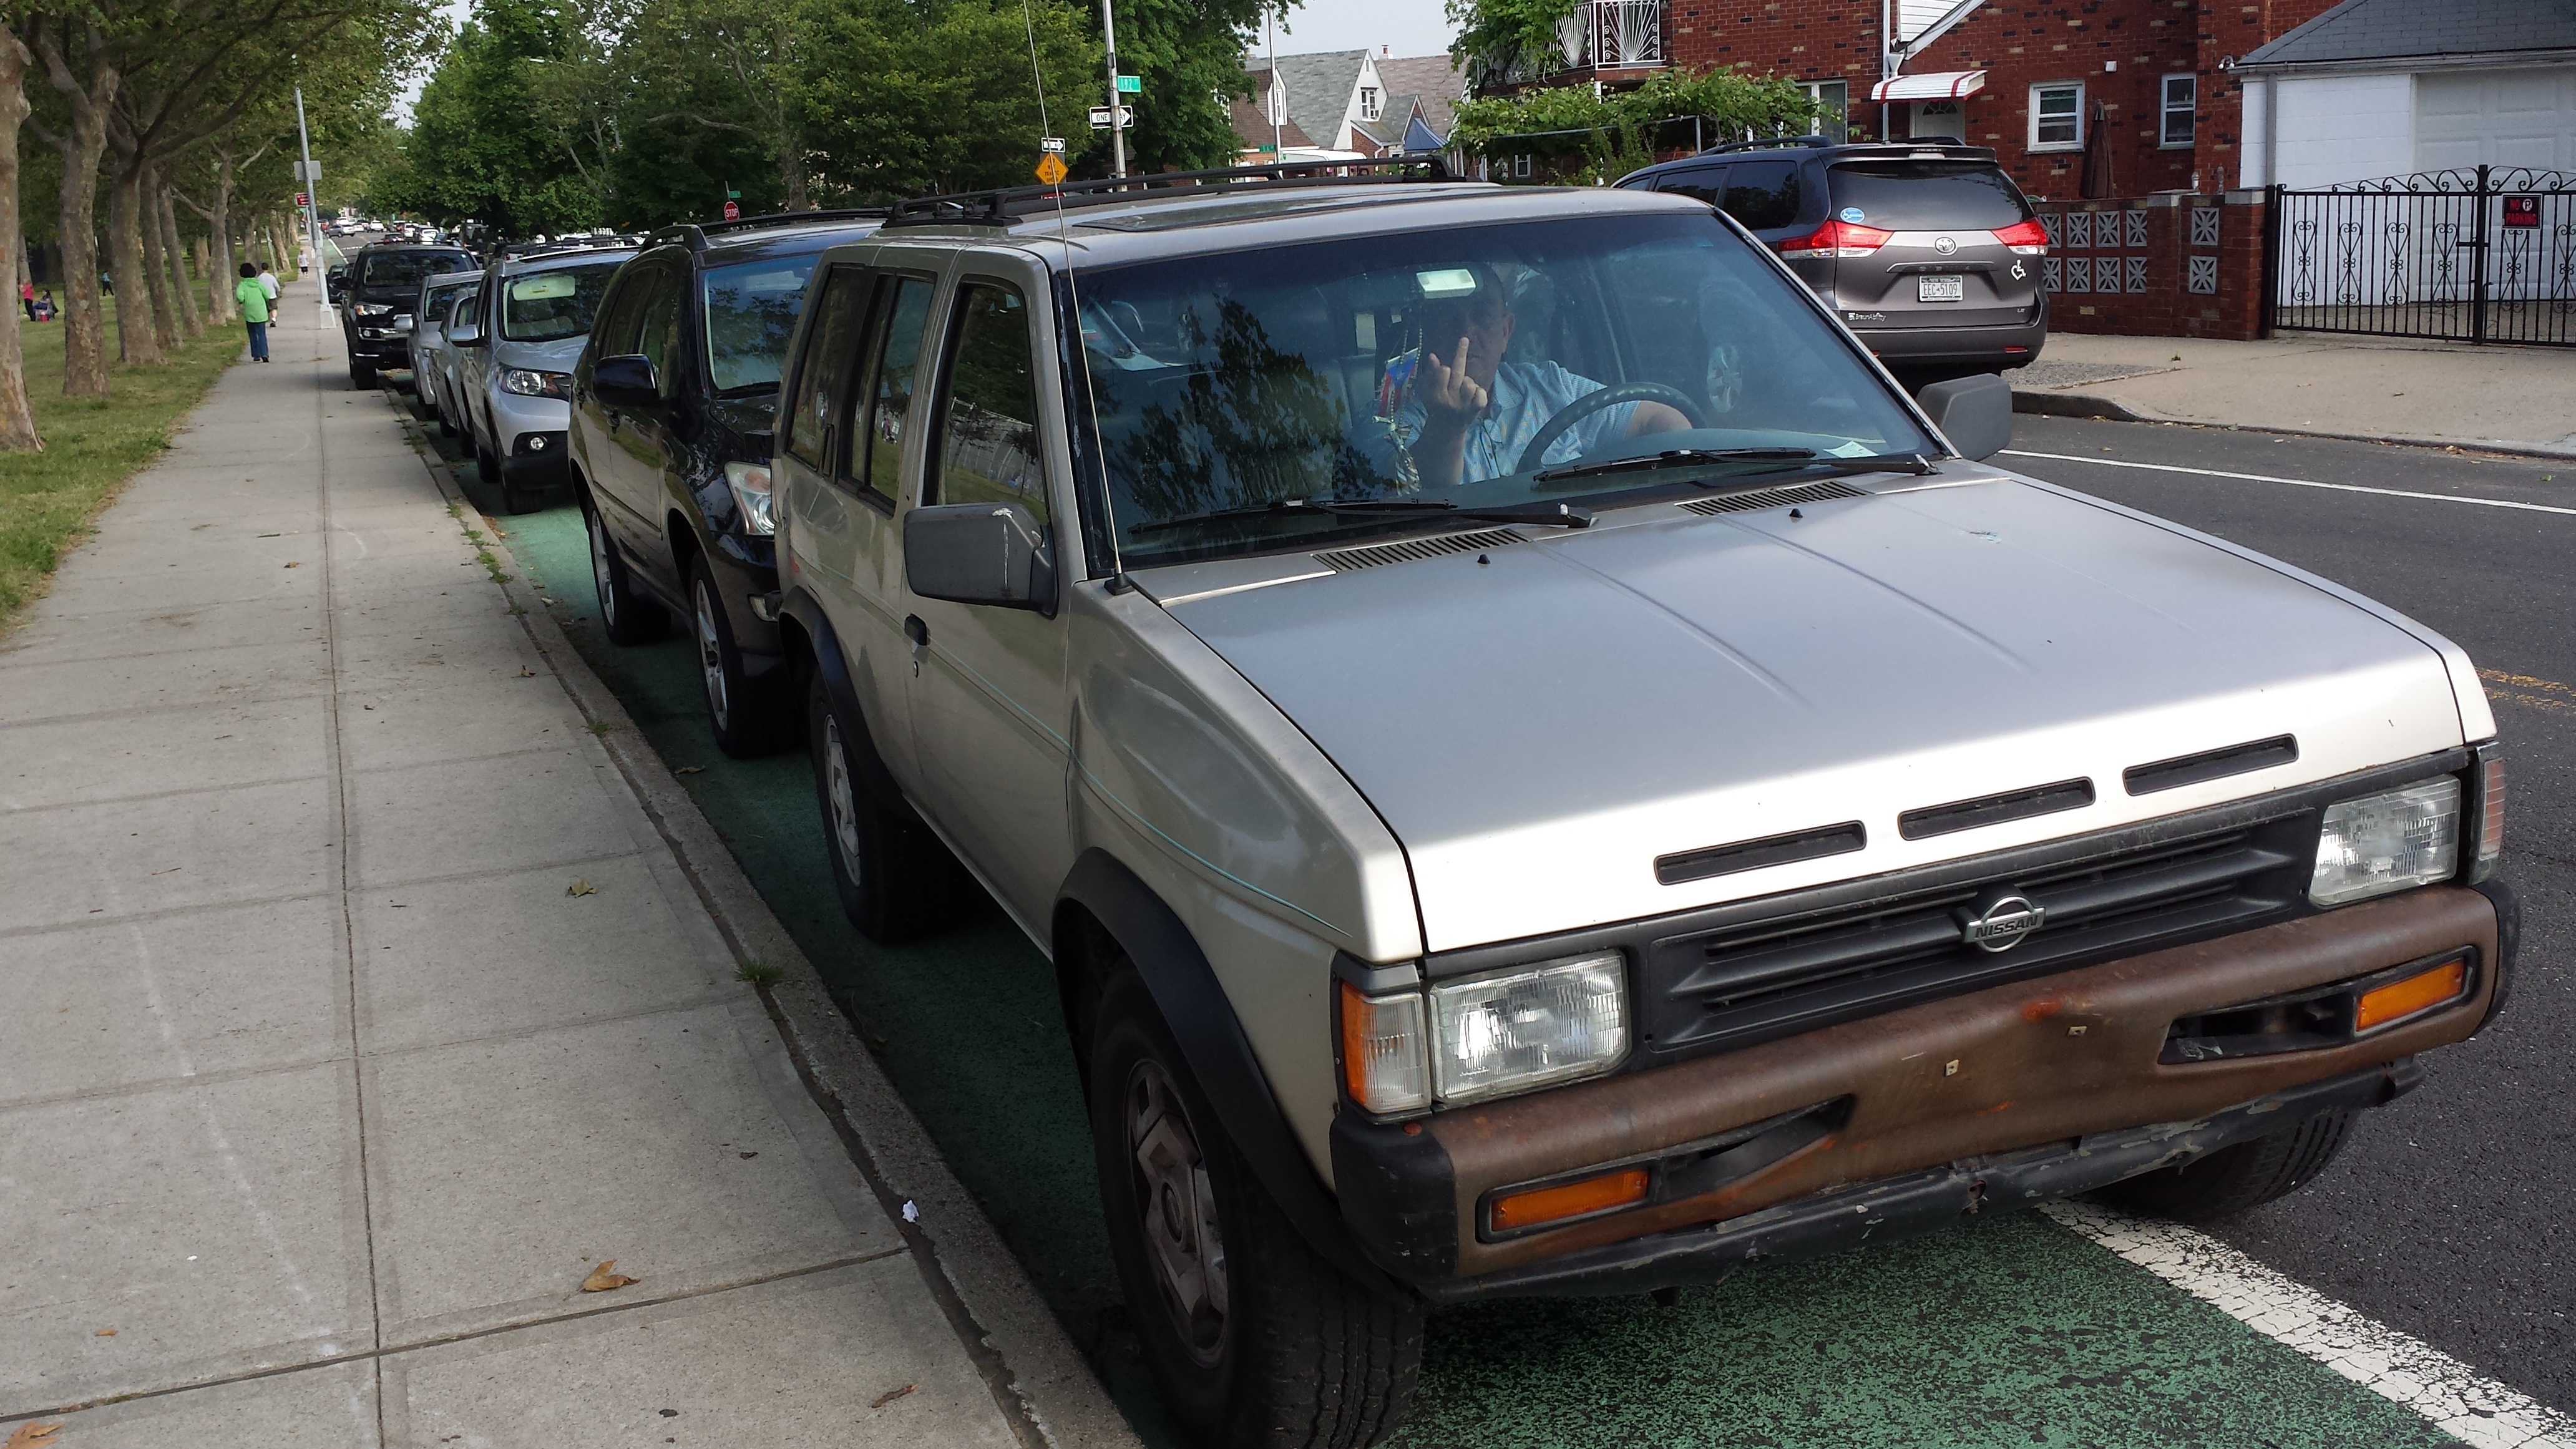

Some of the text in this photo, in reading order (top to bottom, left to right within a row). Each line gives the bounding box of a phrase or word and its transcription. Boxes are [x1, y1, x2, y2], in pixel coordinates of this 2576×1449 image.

[1120, 78, 1133, 90] 192
[2510, 199, 2520, 210] NO
[726, 208, 738, 217] STOP
[2505, 213, 2537, 225] PARKING
[1975, 915, 2038, 937] NISSAN
